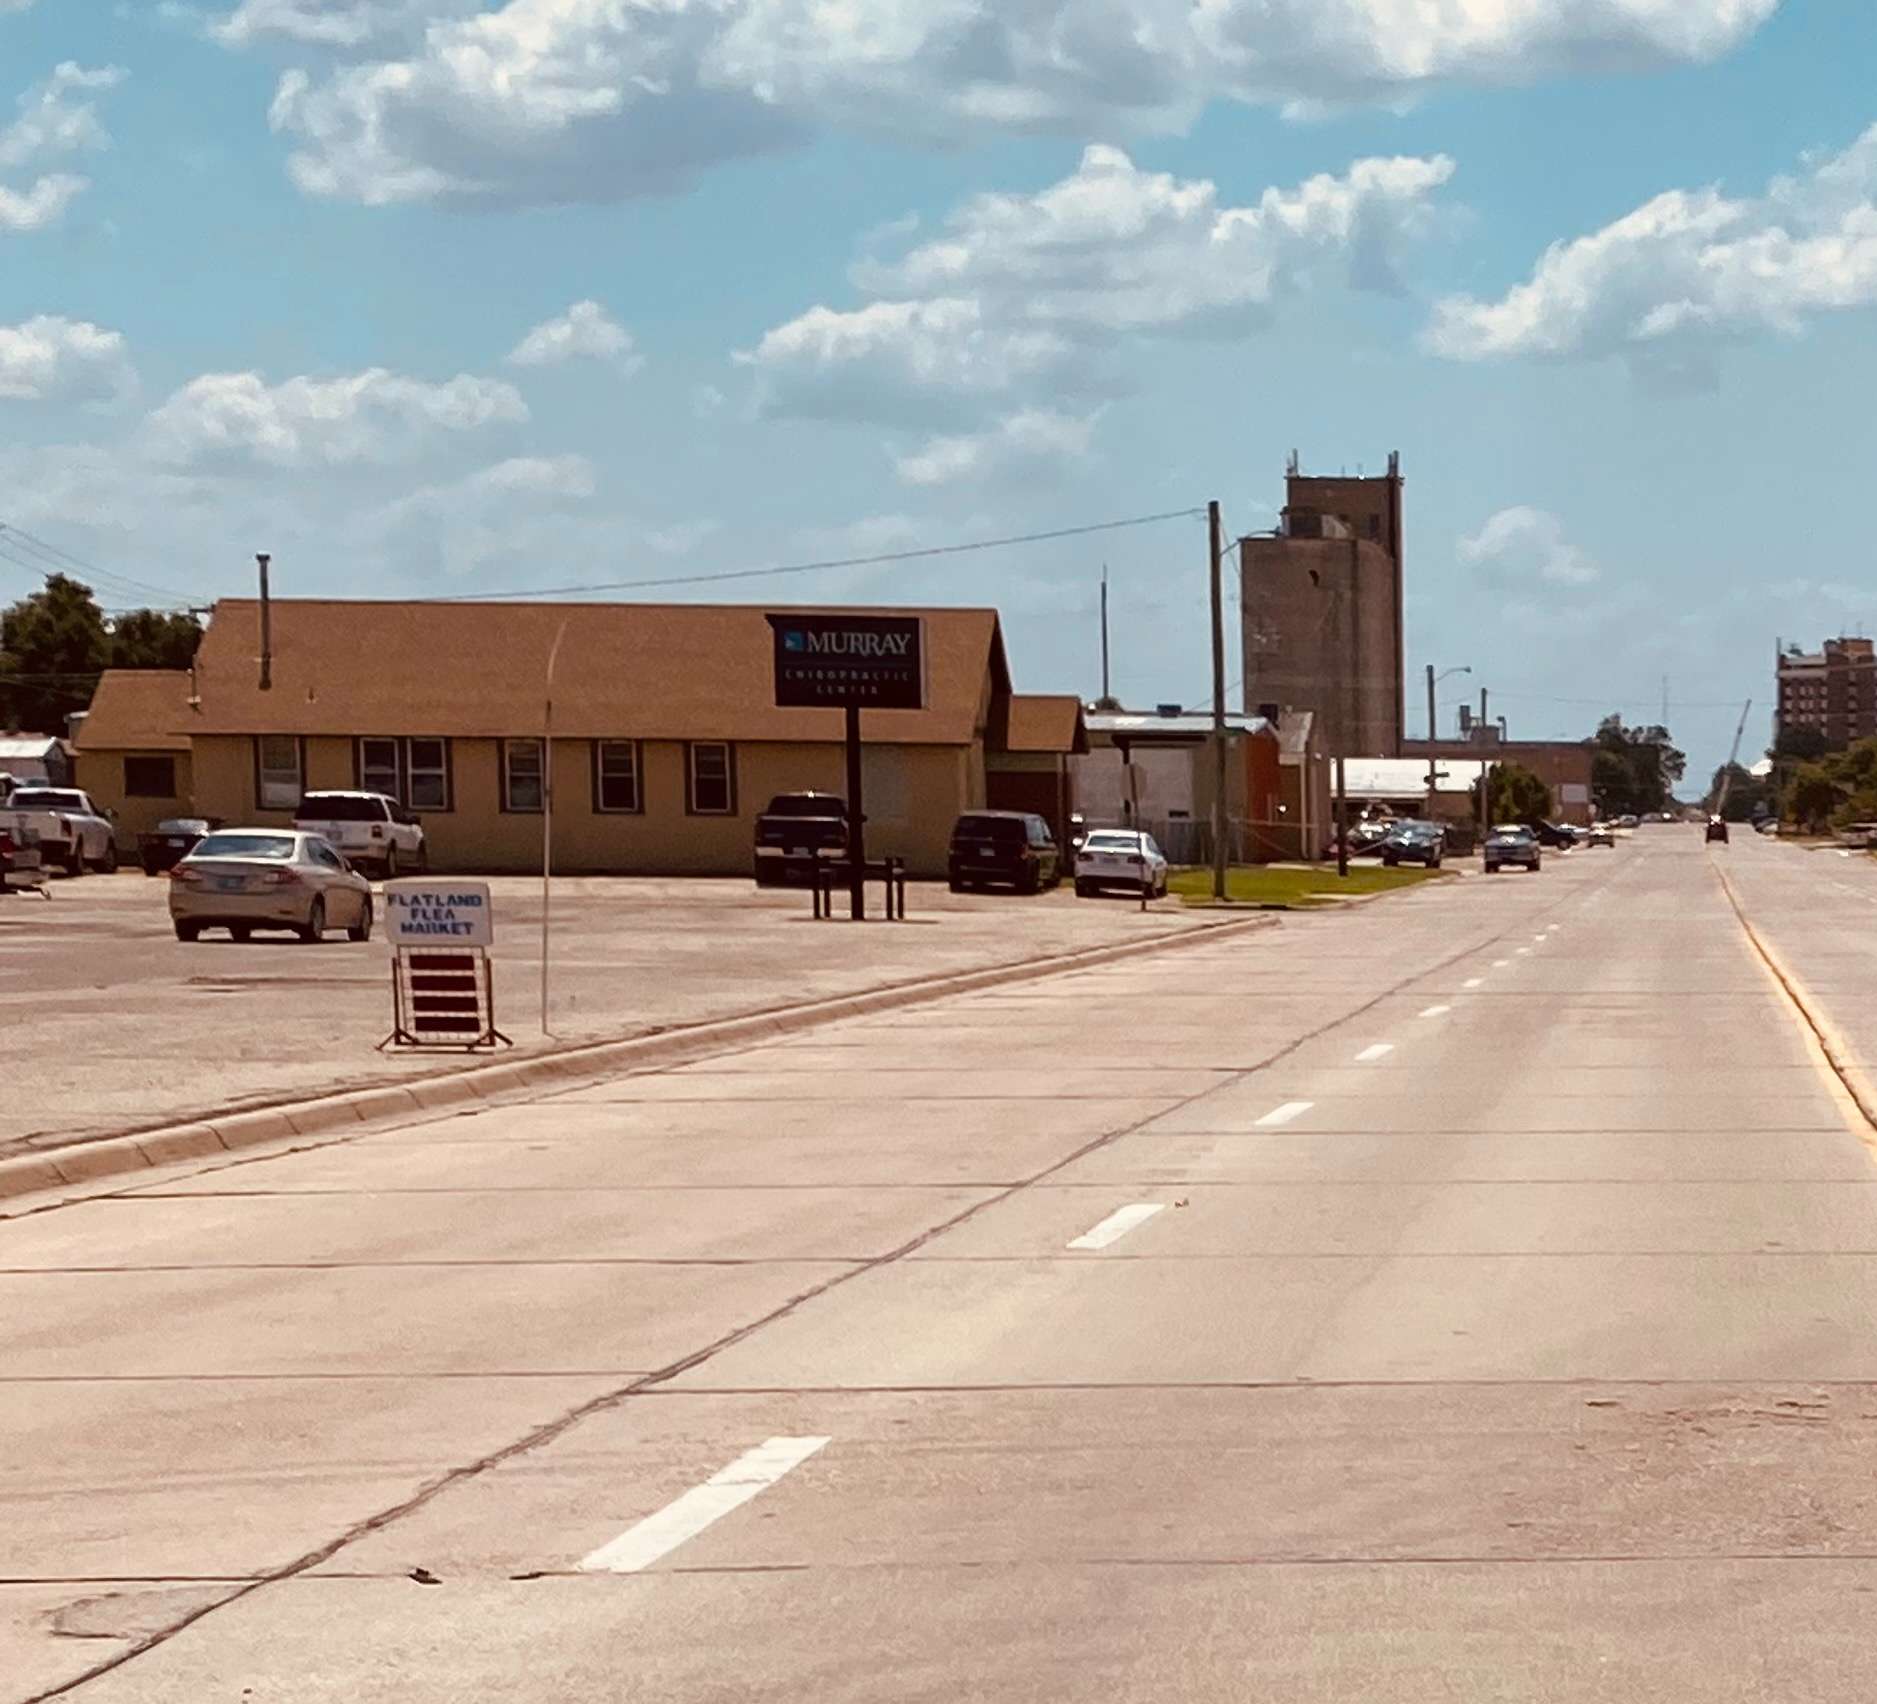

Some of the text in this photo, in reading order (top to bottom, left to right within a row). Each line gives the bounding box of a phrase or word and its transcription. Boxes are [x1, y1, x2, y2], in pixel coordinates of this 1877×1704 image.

[807, 631, 911, 656] MURRAY
[387, 894, 482, 907] FLATLAND
[411, 908, 455, 920] FLEA
[401, 922, 474, 935] MARKET
